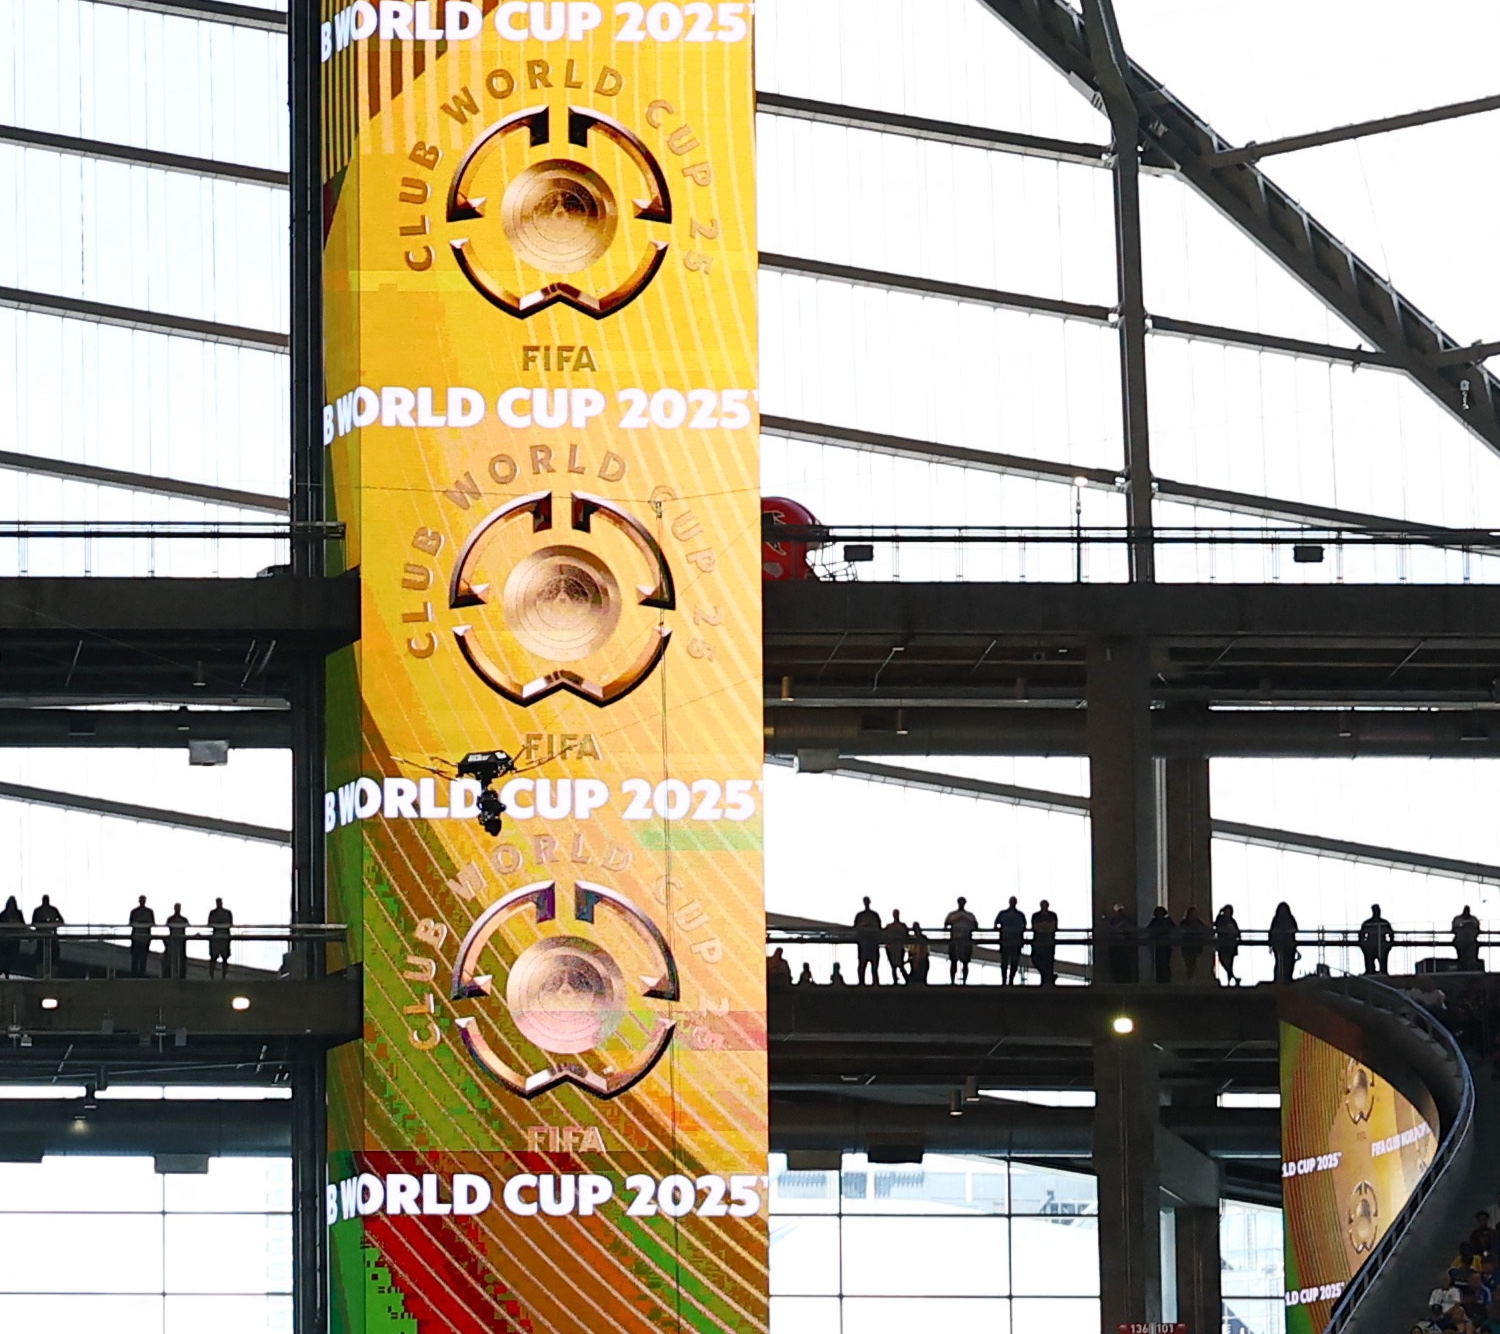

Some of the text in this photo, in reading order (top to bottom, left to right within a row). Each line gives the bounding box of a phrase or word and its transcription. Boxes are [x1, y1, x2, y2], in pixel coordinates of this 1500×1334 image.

[334, 0, 484, 55] WORLD
[494, 1, 602, 43] CUP
[614, 0, 755, 44] 2025
[400, 139, 444, 273] CLUB
[439, 58, 626, 126] WORLD
[645, 99, 716, 191] CUP
[521, 344, 599, 373] FIFA
[336, 387, 486, 438] WORLD
[497, 388, 605, 430] CUP
[617, 388, 758, 430] 2025
[523, 731, 600, 762] FIFA
[502, 778, 610, 820] CUP
[620, 778, 757, 821] 2025
[339, 1174, 490, 1222] WORLD
[504, 1174, 613, 1216] CUP
[626, 1174, 764, 1216] 2025
[1129, 1323, 1150, 1334] 136
[1156, 1323, 1175, 1334] 101
